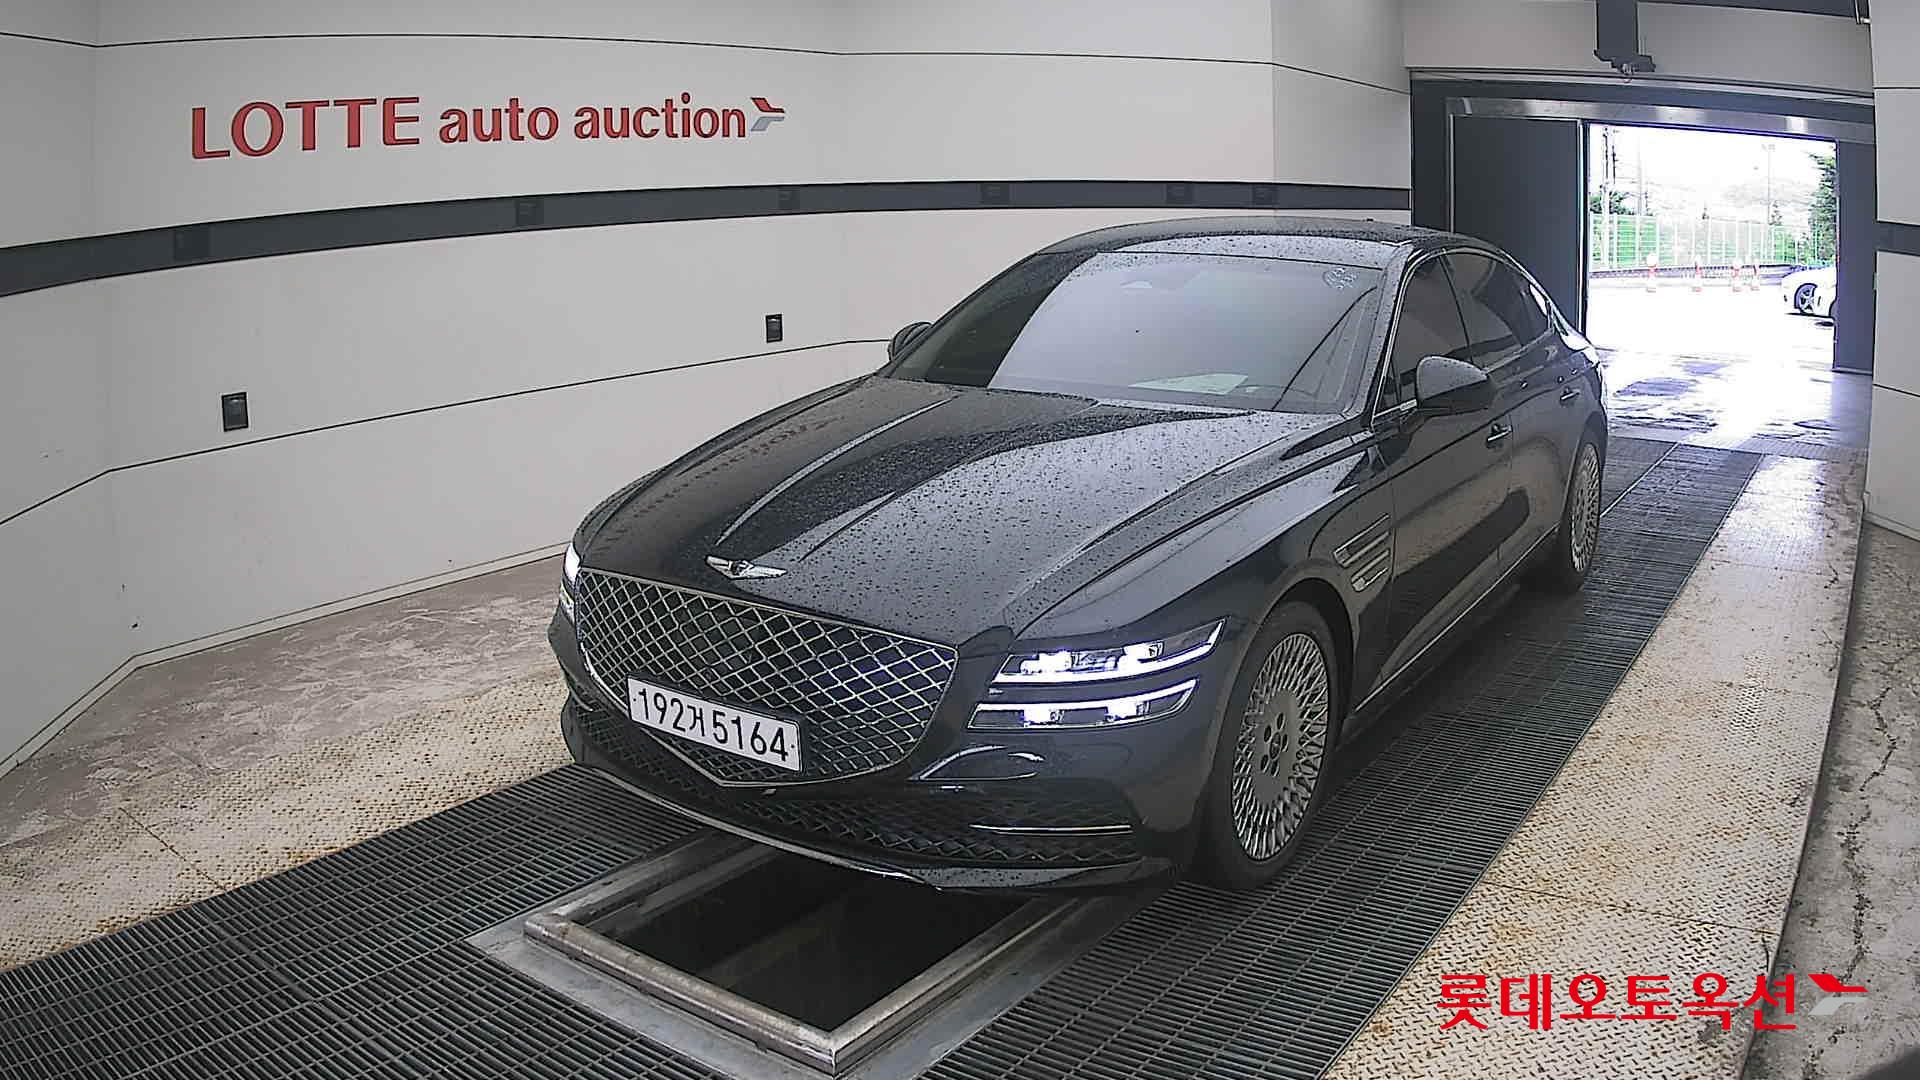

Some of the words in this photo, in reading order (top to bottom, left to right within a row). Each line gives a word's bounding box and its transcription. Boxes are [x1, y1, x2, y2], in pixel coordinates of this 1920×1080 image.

[191, 97, 420, 160] LOTTE
[439, 97, 559, 144] auto
[573, 91, 747, 140] auction
